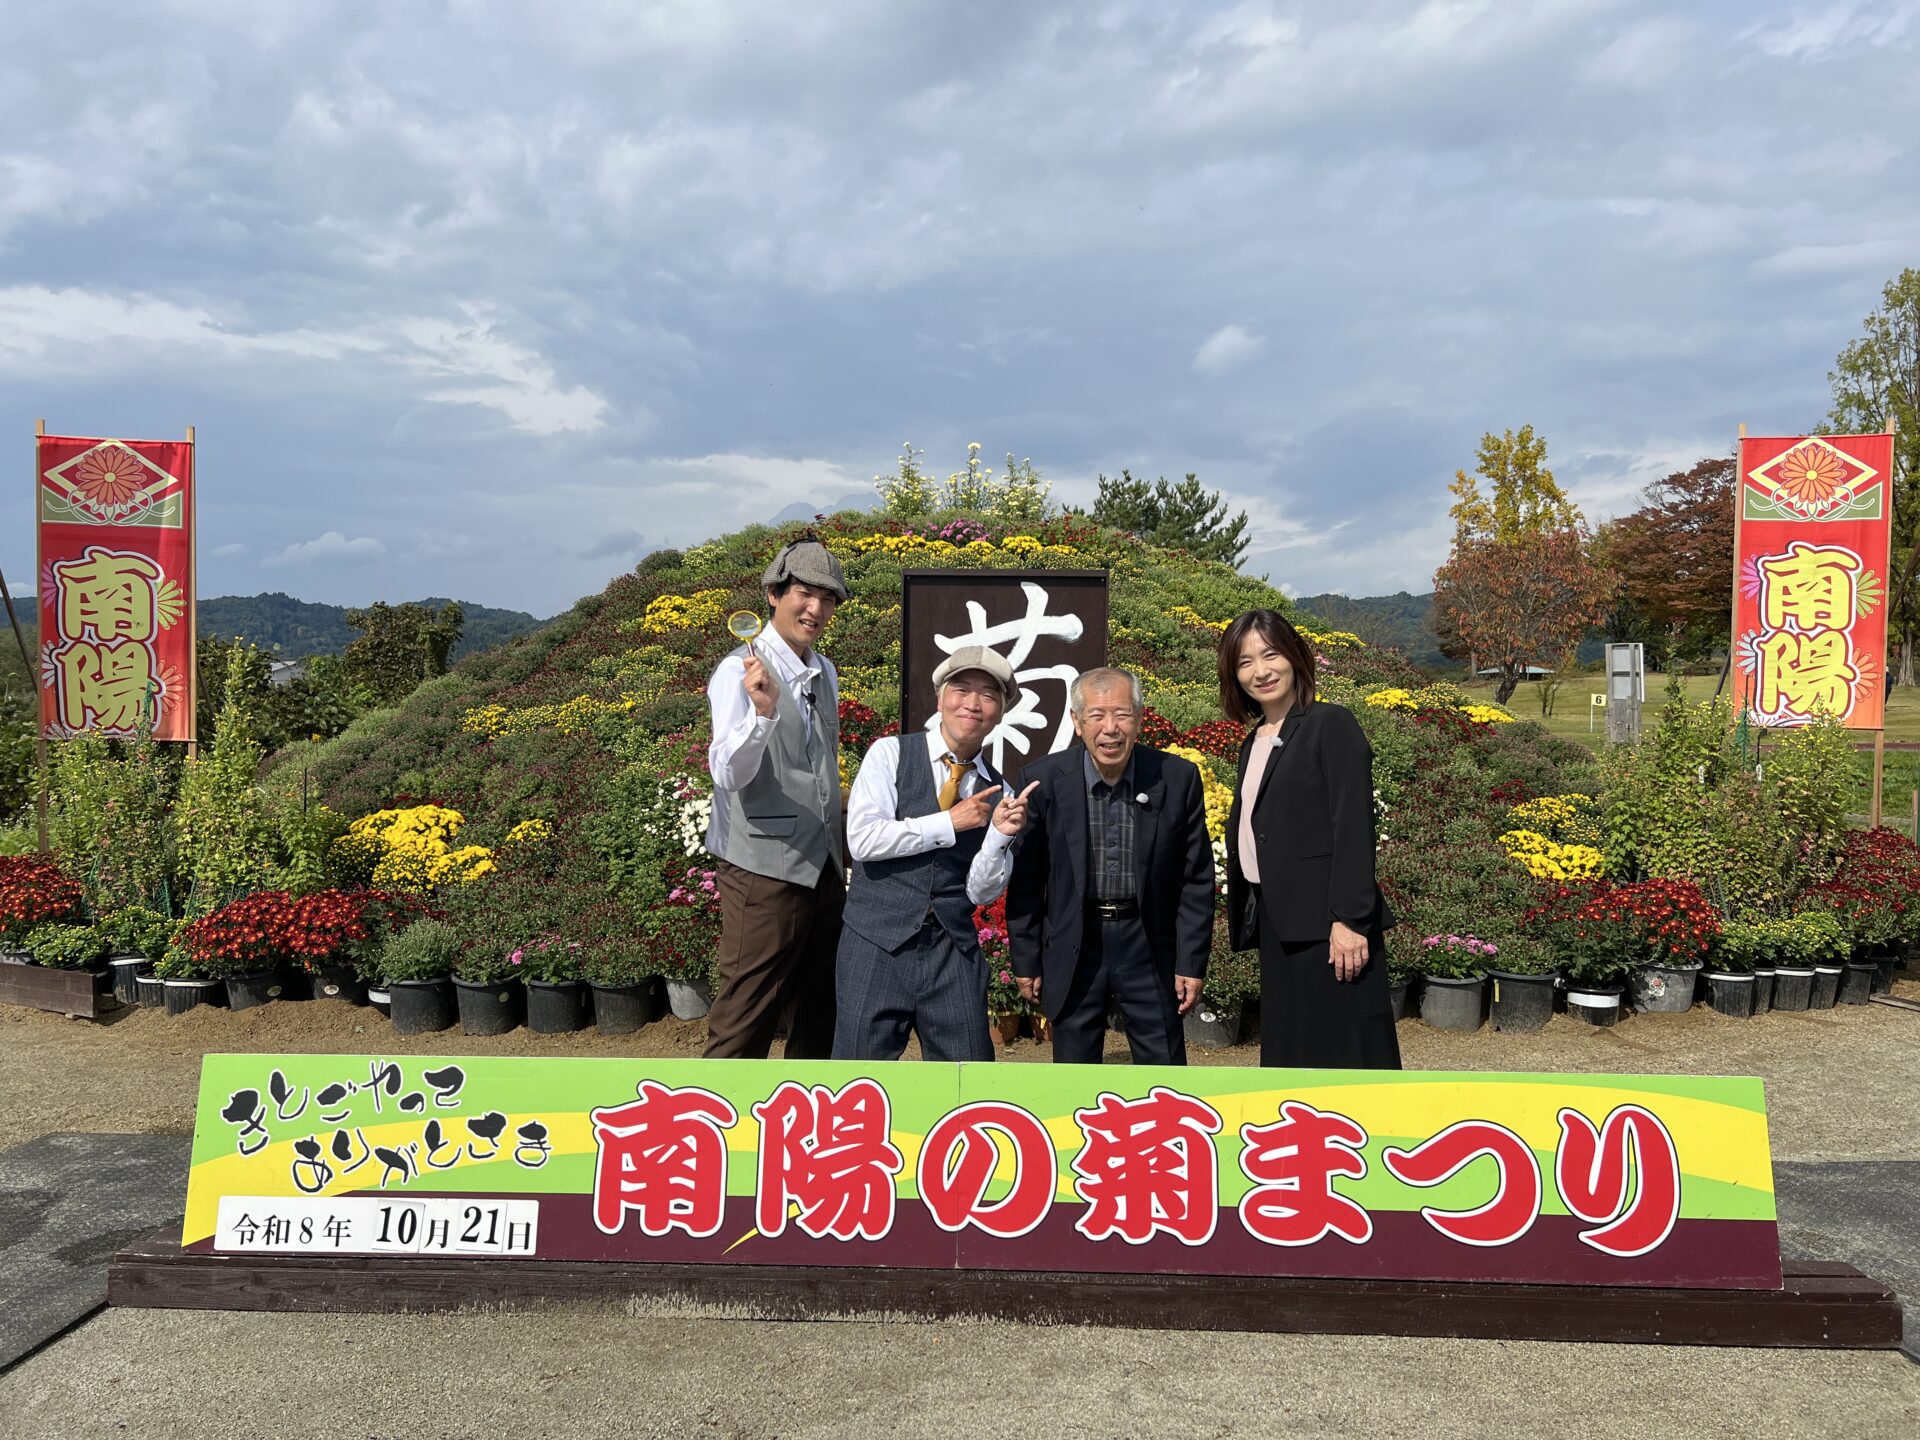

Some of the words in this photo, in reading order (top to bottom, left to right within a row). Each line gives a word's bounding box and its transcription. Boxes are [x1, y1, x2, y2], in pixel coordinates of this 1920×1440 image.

[54, 547, 164, 732] 南陽
[1595, 695, 1603, 705] 6
[1755, 543, 1861, 718] 南陽
[293, 1112, 552, 1193] ありがとさま
[592, 1078, 1680, 1257] 南陽の菊まつり
